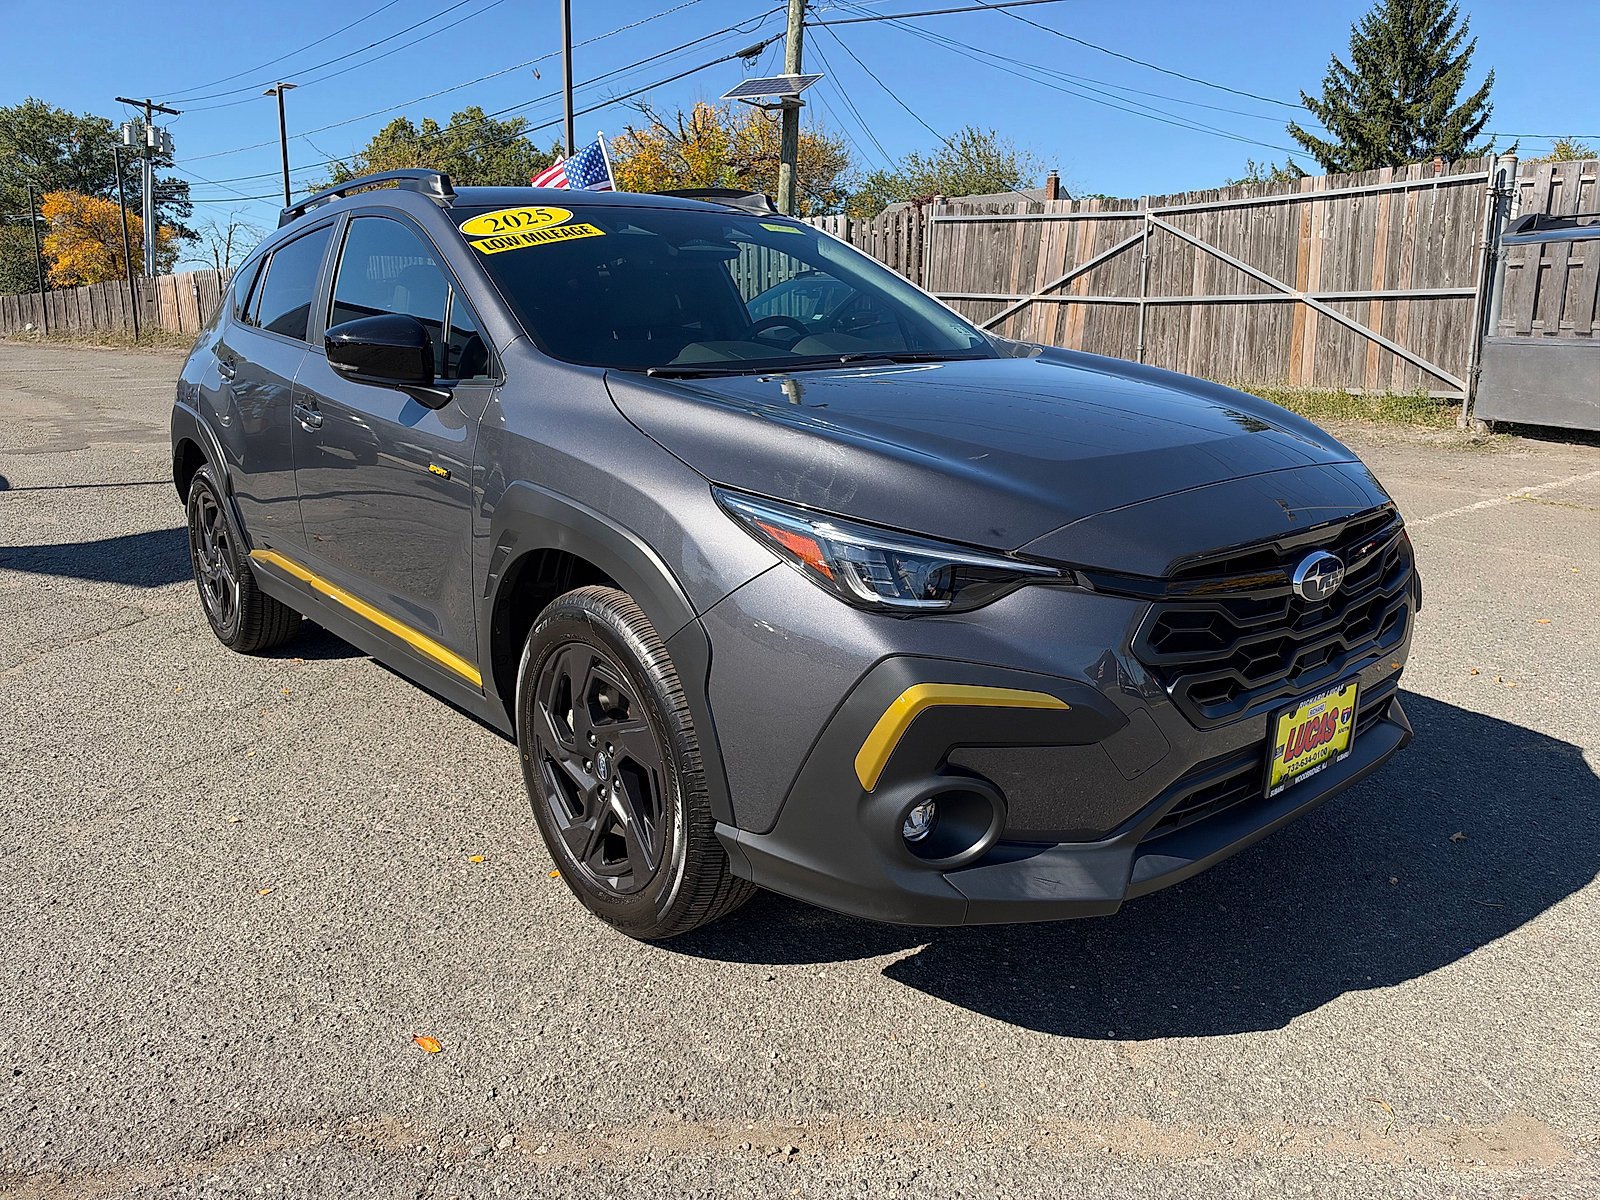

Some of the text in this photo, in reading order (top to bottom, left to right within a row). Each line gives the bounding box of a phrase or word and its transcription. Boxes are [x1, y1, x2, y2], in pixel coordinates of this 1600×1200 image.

[484, 208, 553, 232] 2025
[481, 225, 593, 251] LOW MILEAGE
[428, 464, 448, 477] SPORT
[1299, 692, 1326, 709] RICHARD
[1283, 707, 1339, 764] LUCAS
[1287, 747, 1329, 773] 732-634-0100
